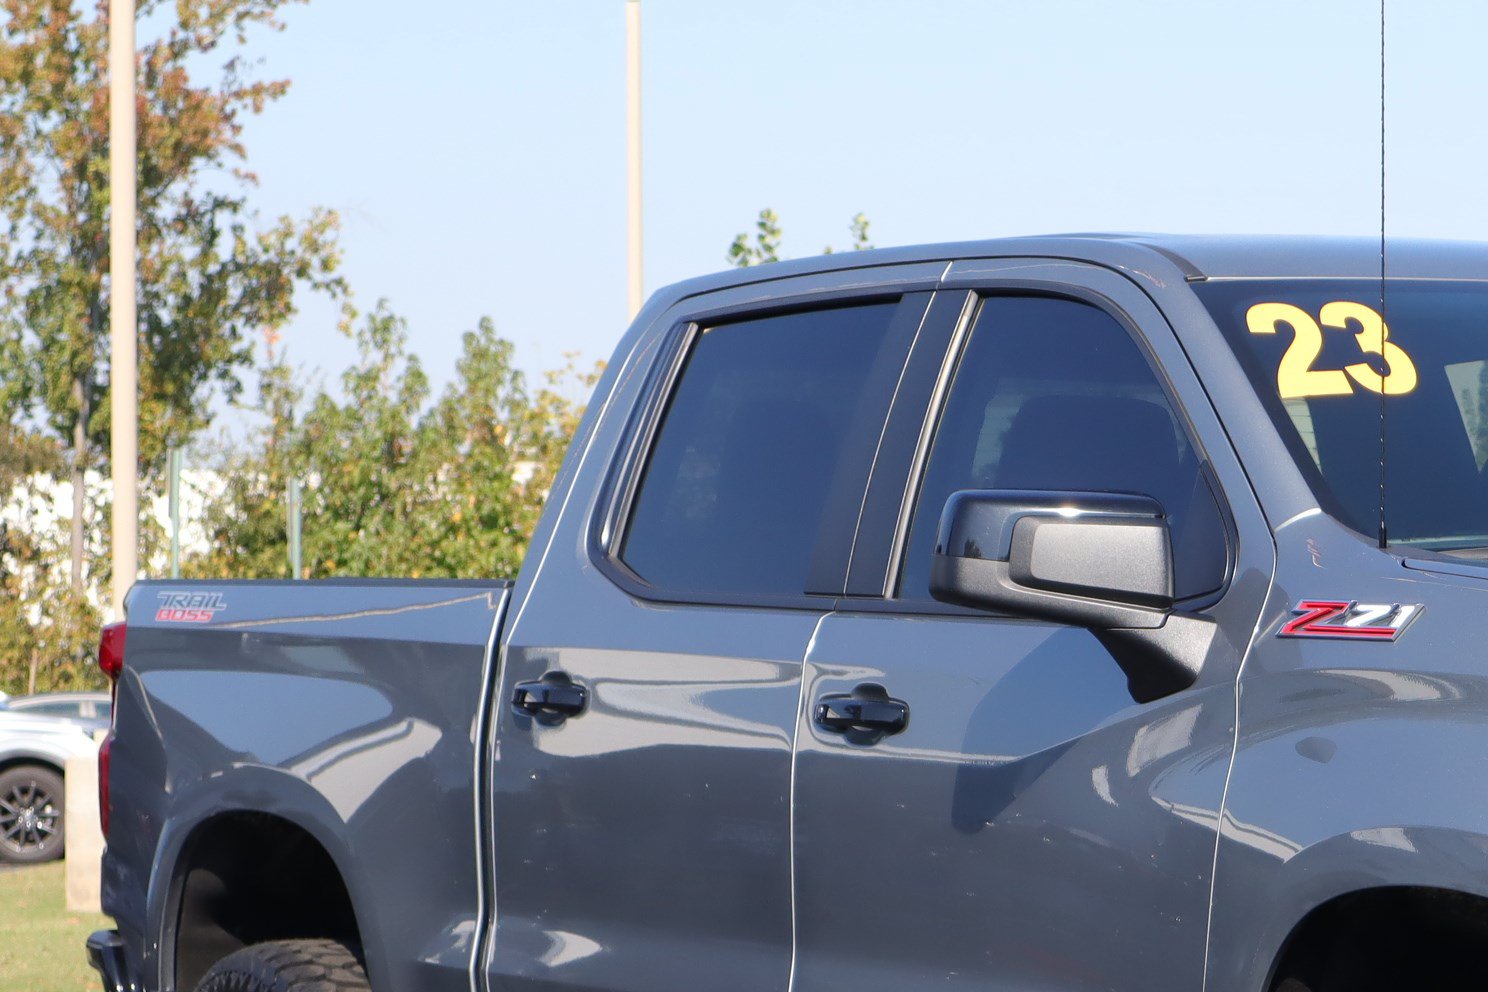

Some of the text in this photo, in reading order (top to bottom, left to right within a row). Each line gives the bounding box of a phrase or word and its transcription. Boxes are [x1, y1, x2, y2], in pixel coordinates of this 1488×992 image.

[1245, 300, 1418, 399] 23
[155, 609, 214, 623] BOSS
[156, 590, 227, 611] TRAIL
[1276, 599, 1425, 642] Z71
